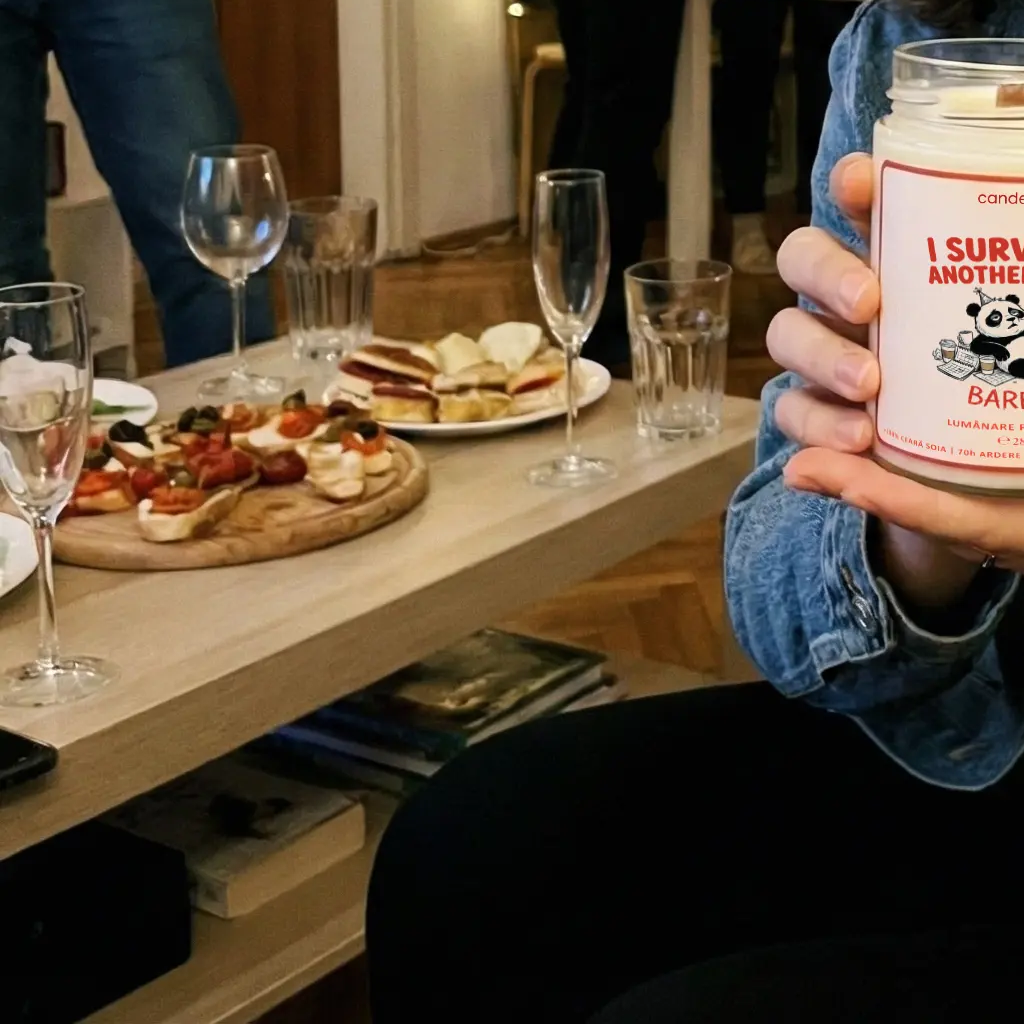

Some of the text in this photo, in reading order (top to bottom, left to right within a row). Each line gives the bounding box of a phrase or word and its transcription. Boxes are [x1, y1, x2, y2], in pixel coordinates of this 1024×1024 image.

[927, 237, 937, 262] I
[947, 418, 1015, 431] LUMÂNARE
[925, 442, 946, 453] SOIA
[958, 448, 976, 456] 70h
[979, 451, 1021, 459] ARDERE
